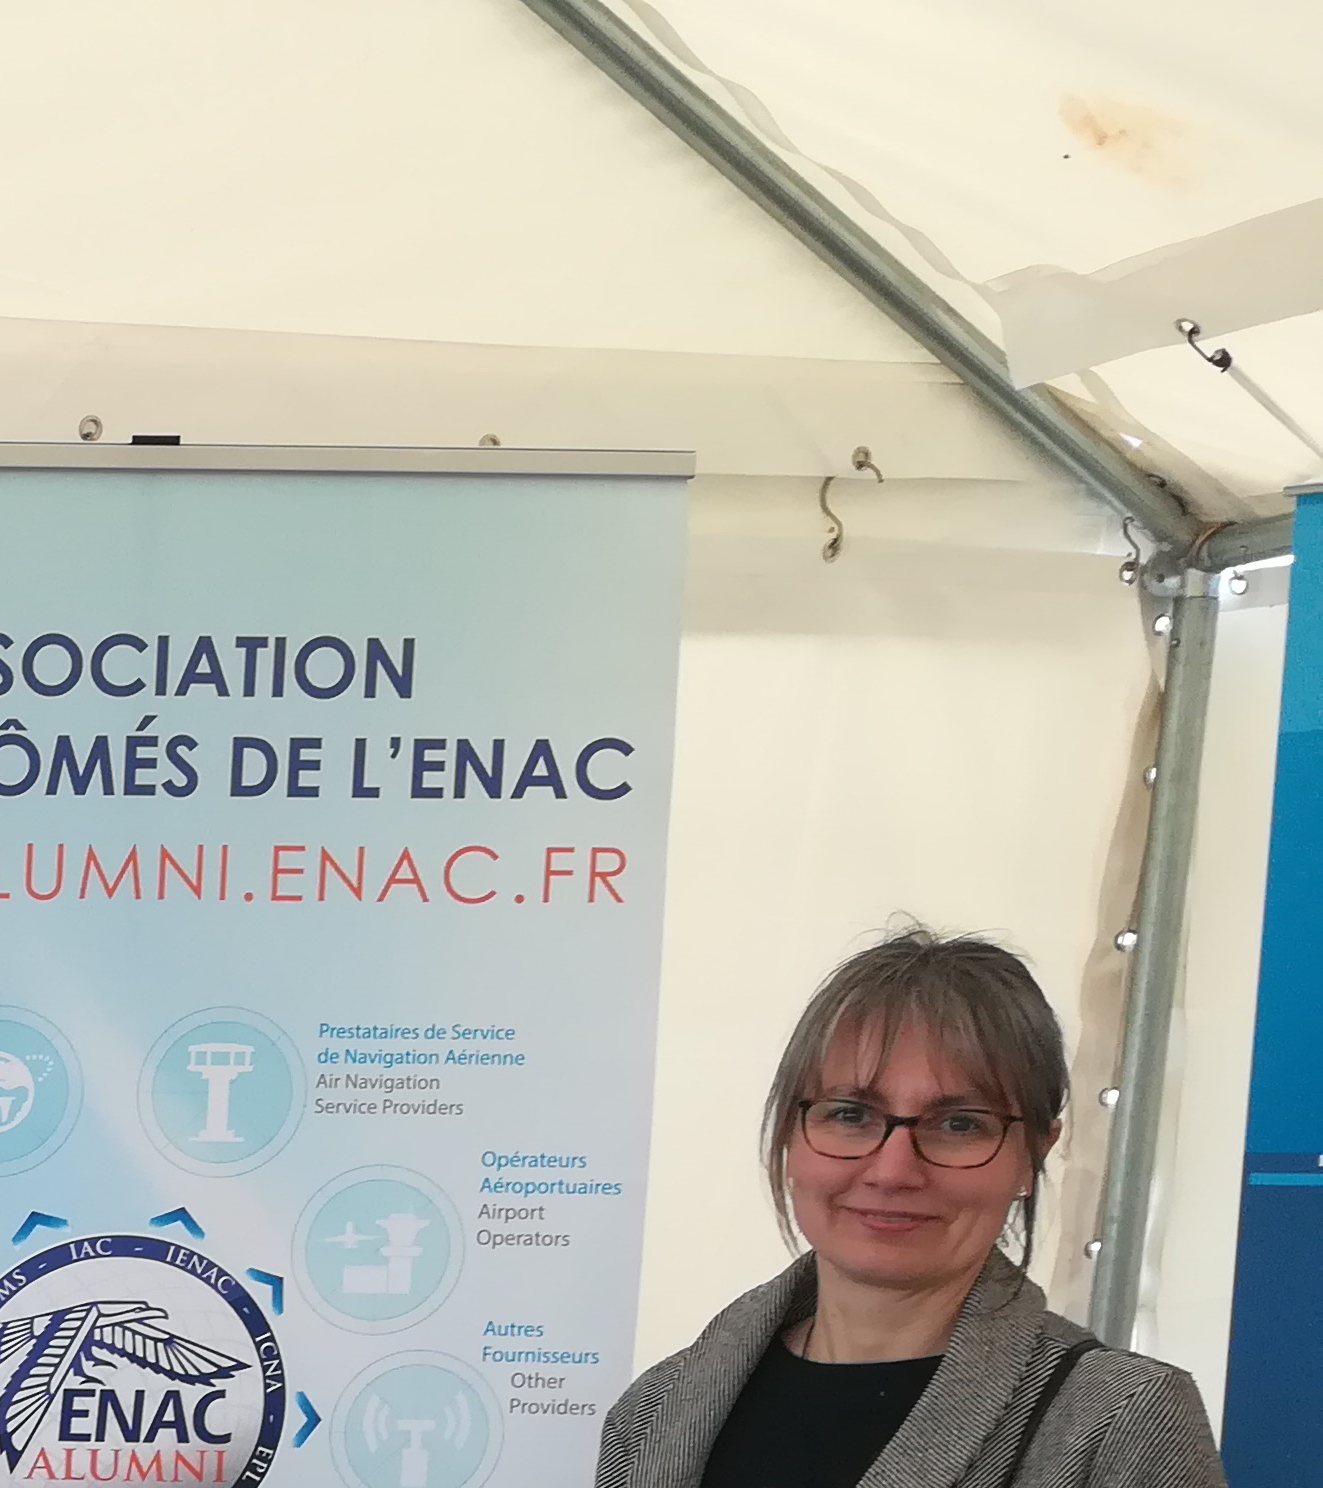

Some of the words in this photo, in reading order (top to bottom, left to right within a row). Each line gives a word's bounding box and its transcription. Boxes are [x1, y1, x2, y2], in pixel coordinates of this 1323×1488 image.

[229, 737, 324, 799] DE
[318, 1023, 421, 1041] Prestataires
[425, 1024, 448, 1041] de
[452, 1024, 515, 1041] Service
[317, 1048, 340, 1065] de
[345, 1048, 440, 1069] Navigation
[444, 1048, 526, 1067] Aérienne
[315, 1073, 341, 1090] Air
[345, 1073, 441, 1093] Navigation
[314, 1098, 377, 1115] Service
[382, 1098, 464, 1116] Providers
[481, 1151, 587, 1173] Opérateurs
[480, 1177, 622, 1200] Aéroportuaires
[478, 1203, 545, 1226] Airport
[69, 1237, 113, 1261] IAC
[476, 1230, 571, 1251] Operators
[165, 1244, 236, 1295] IENAC
[483, 1320, 545, 1340] Autres
[254, 1331, 283, 1393] ICNA
[481, 1347, 601, 1366] Fournisseurs
[510, 1372, 566, 1391] Other
[58, 1388, 232, 1444] ENAC
[508, 1398, 597, 1417] Providers
[23, 1446, 228, 1483] ALUMNI
[245, 1445, 274, 1483] EPL
